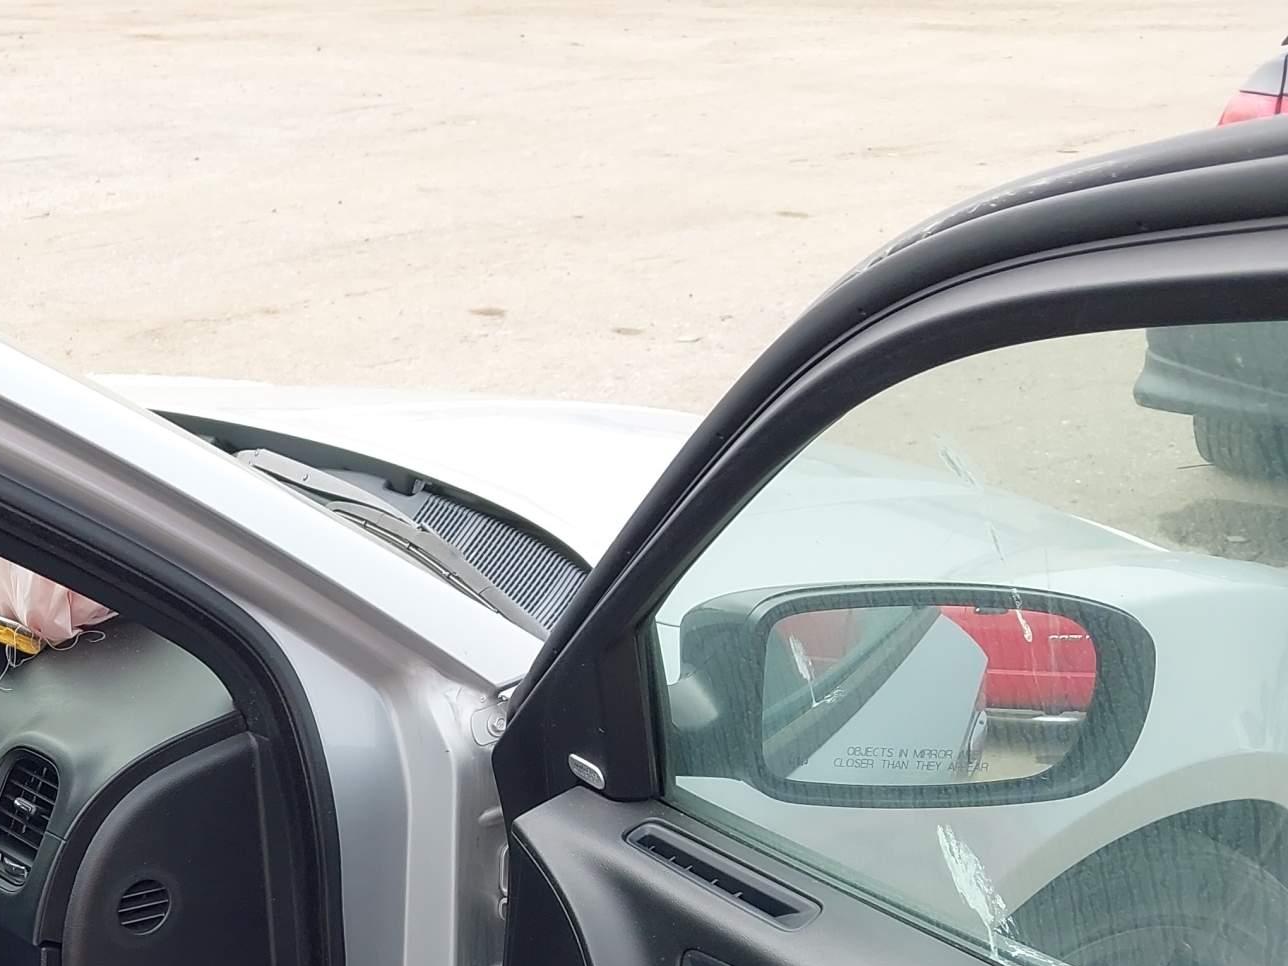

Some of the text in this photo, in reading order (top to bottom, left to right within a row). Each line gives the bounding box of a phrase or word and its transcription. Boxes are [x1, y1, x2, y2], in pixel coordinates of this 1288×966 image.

[847, 746, 894, 758] OBJECTS
[899, 749, 909, 759] IN
[912, 749, 953, 760] MIRROR
[833, 758, 874, 769] CLOSER
[882, 760, 908, 769] THAN
[916, 761, 941, 771] THEY
